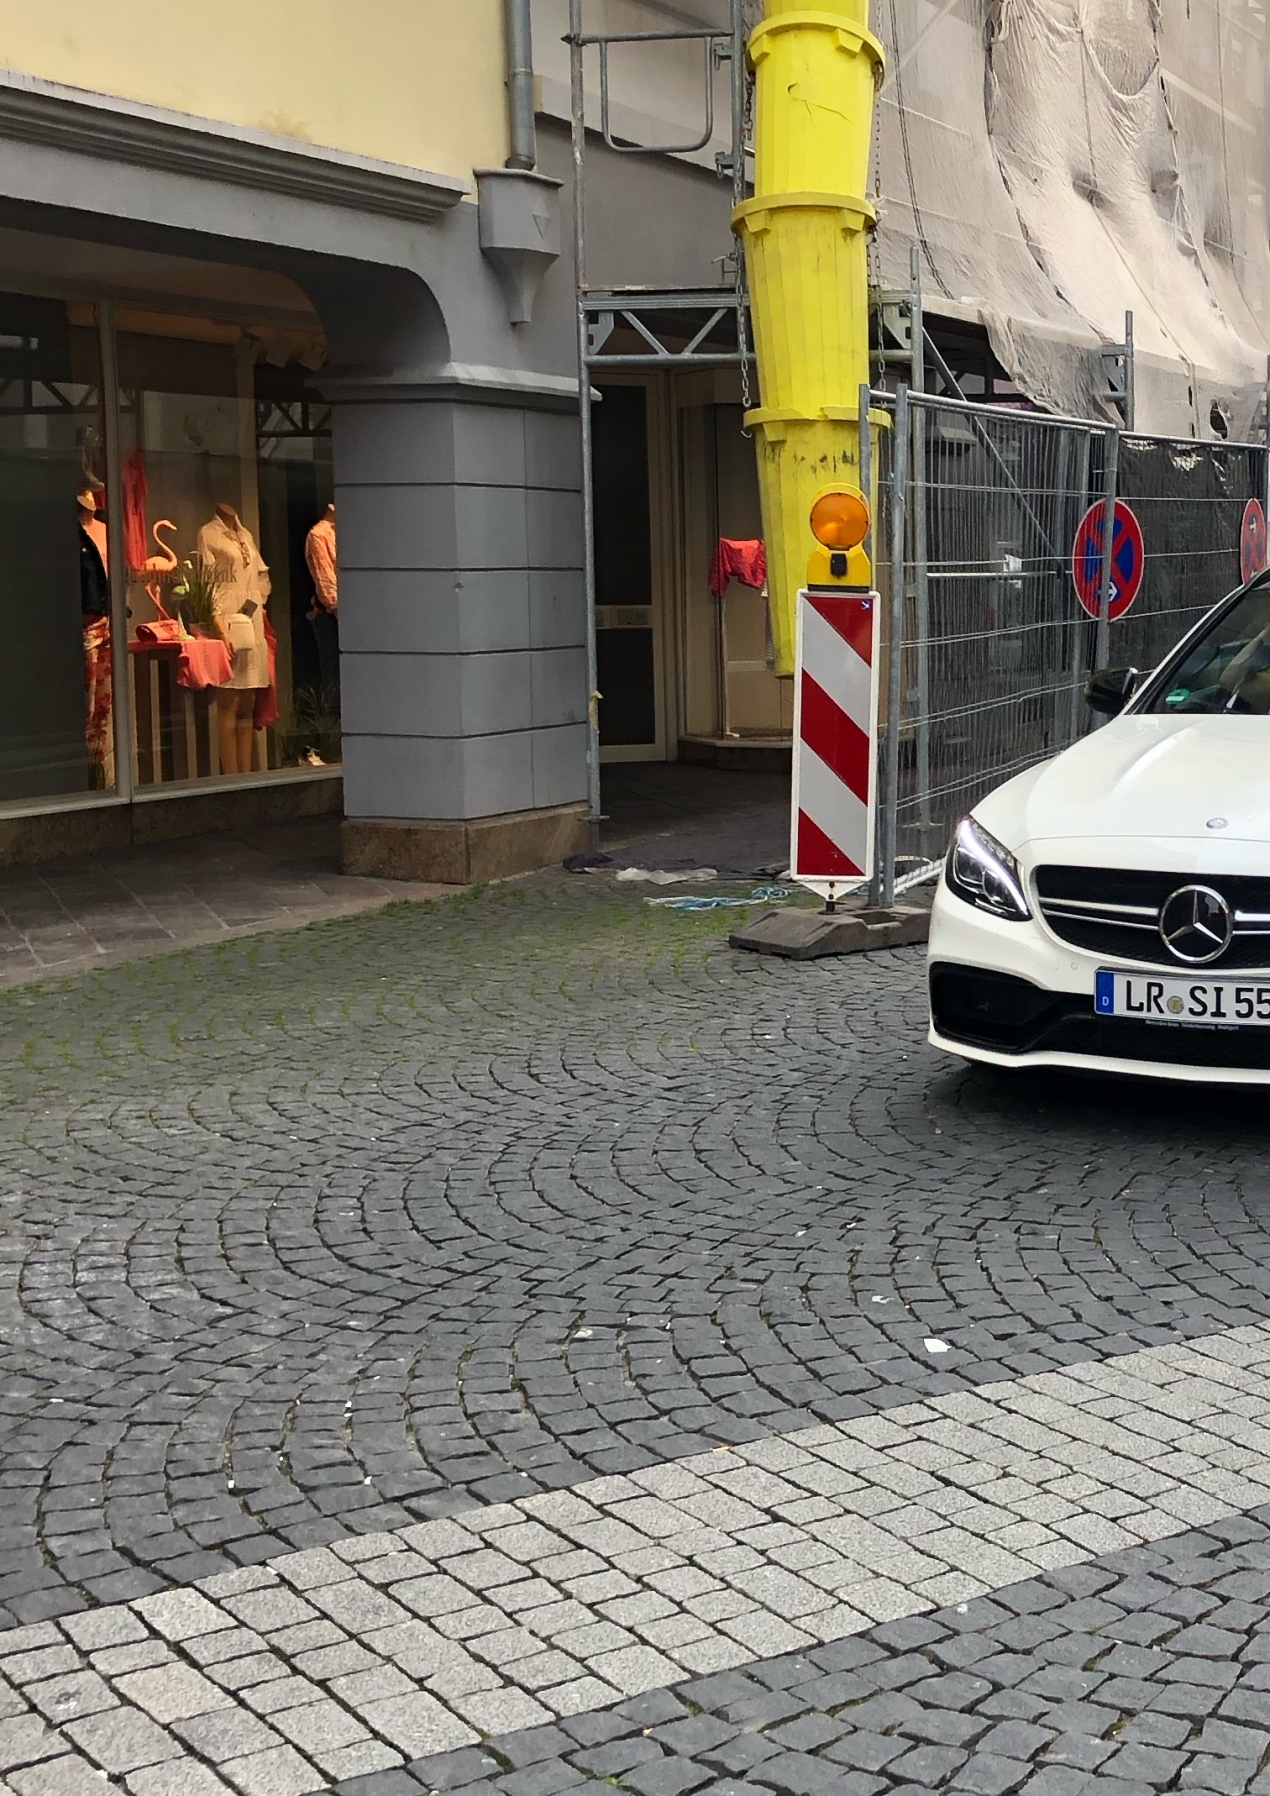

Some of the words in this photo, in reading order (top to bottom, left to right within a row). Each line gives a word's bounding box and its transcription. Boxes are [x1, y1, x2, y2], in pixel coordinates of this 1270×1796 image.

[1102, 996, 1109, 1006] D
[1126, 980, 1164, 1014] LR
[1188, 986, 1227, 1017] SI
